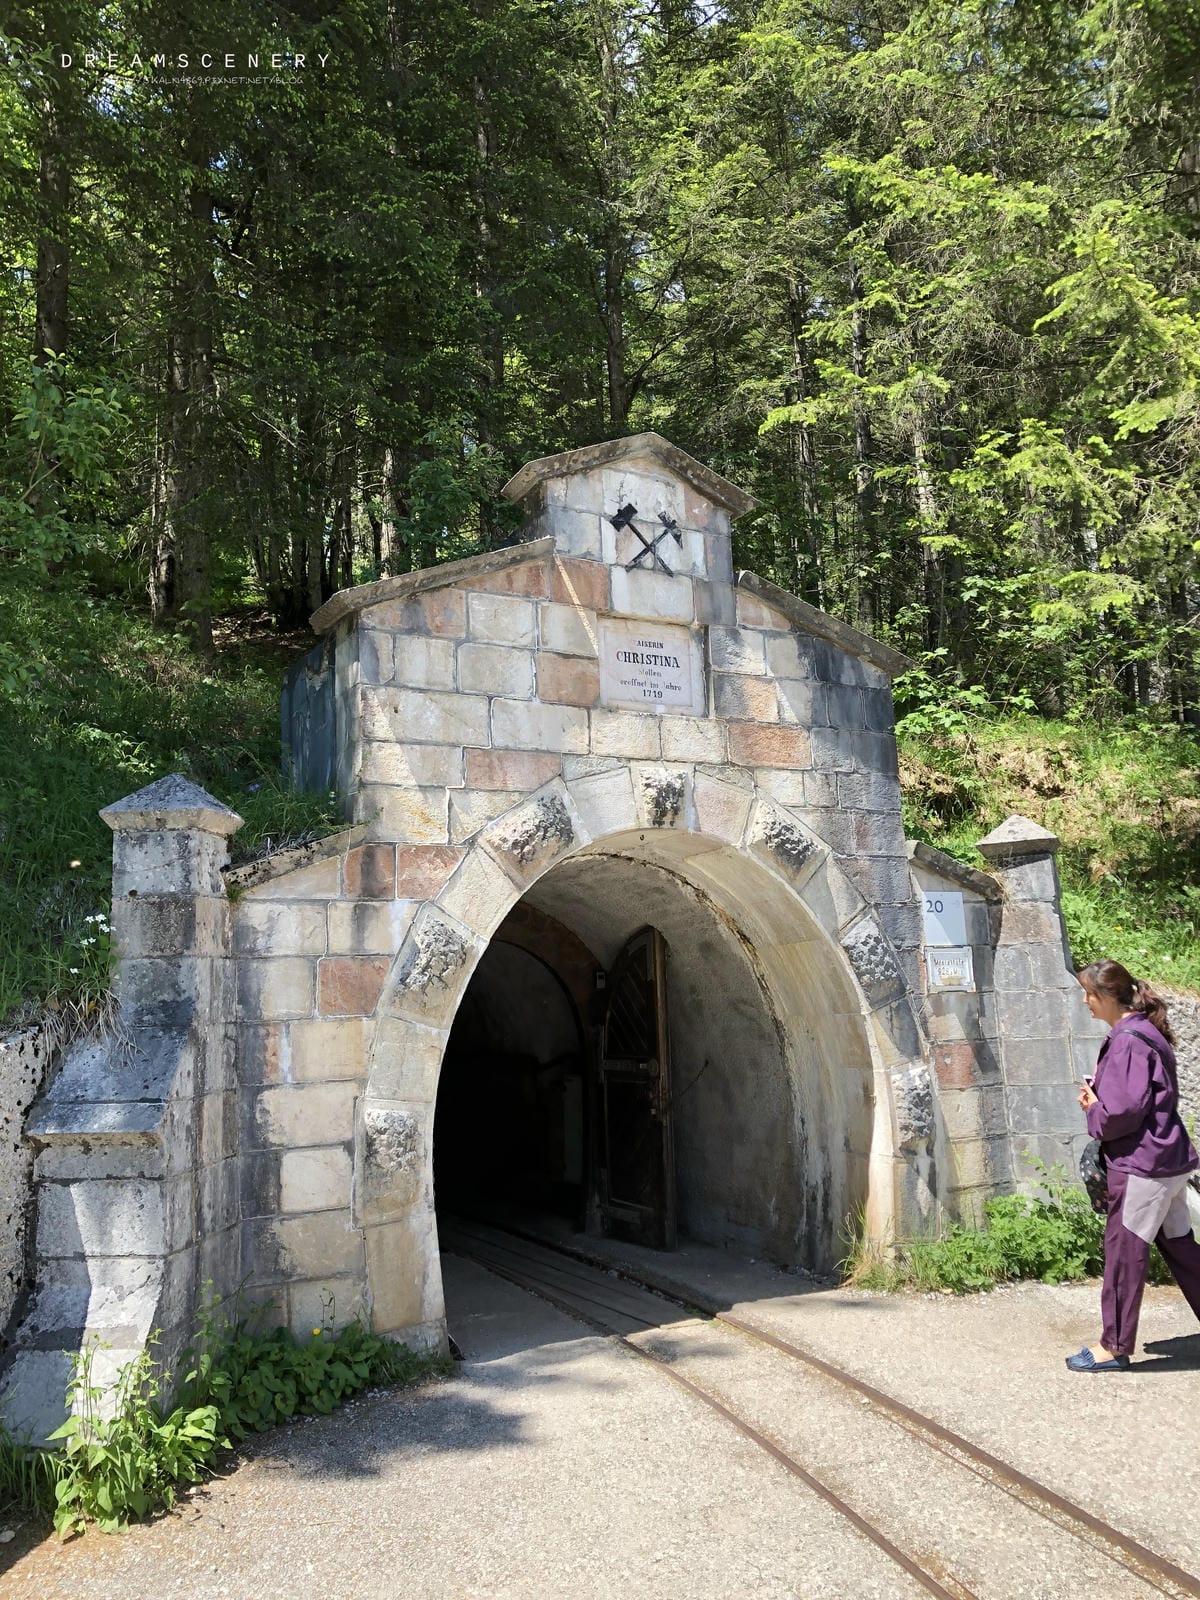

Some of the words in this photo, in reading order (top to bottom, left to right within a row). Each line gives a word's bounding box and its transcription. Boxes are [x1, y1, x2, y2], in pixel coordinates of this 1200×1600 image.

[632, 640, 664, 649] AISERIN
[616, 650, 681, 668] CHRISTINA
[642, 688, 663, 699] 1719
[926, 899, 944, 914] 20
